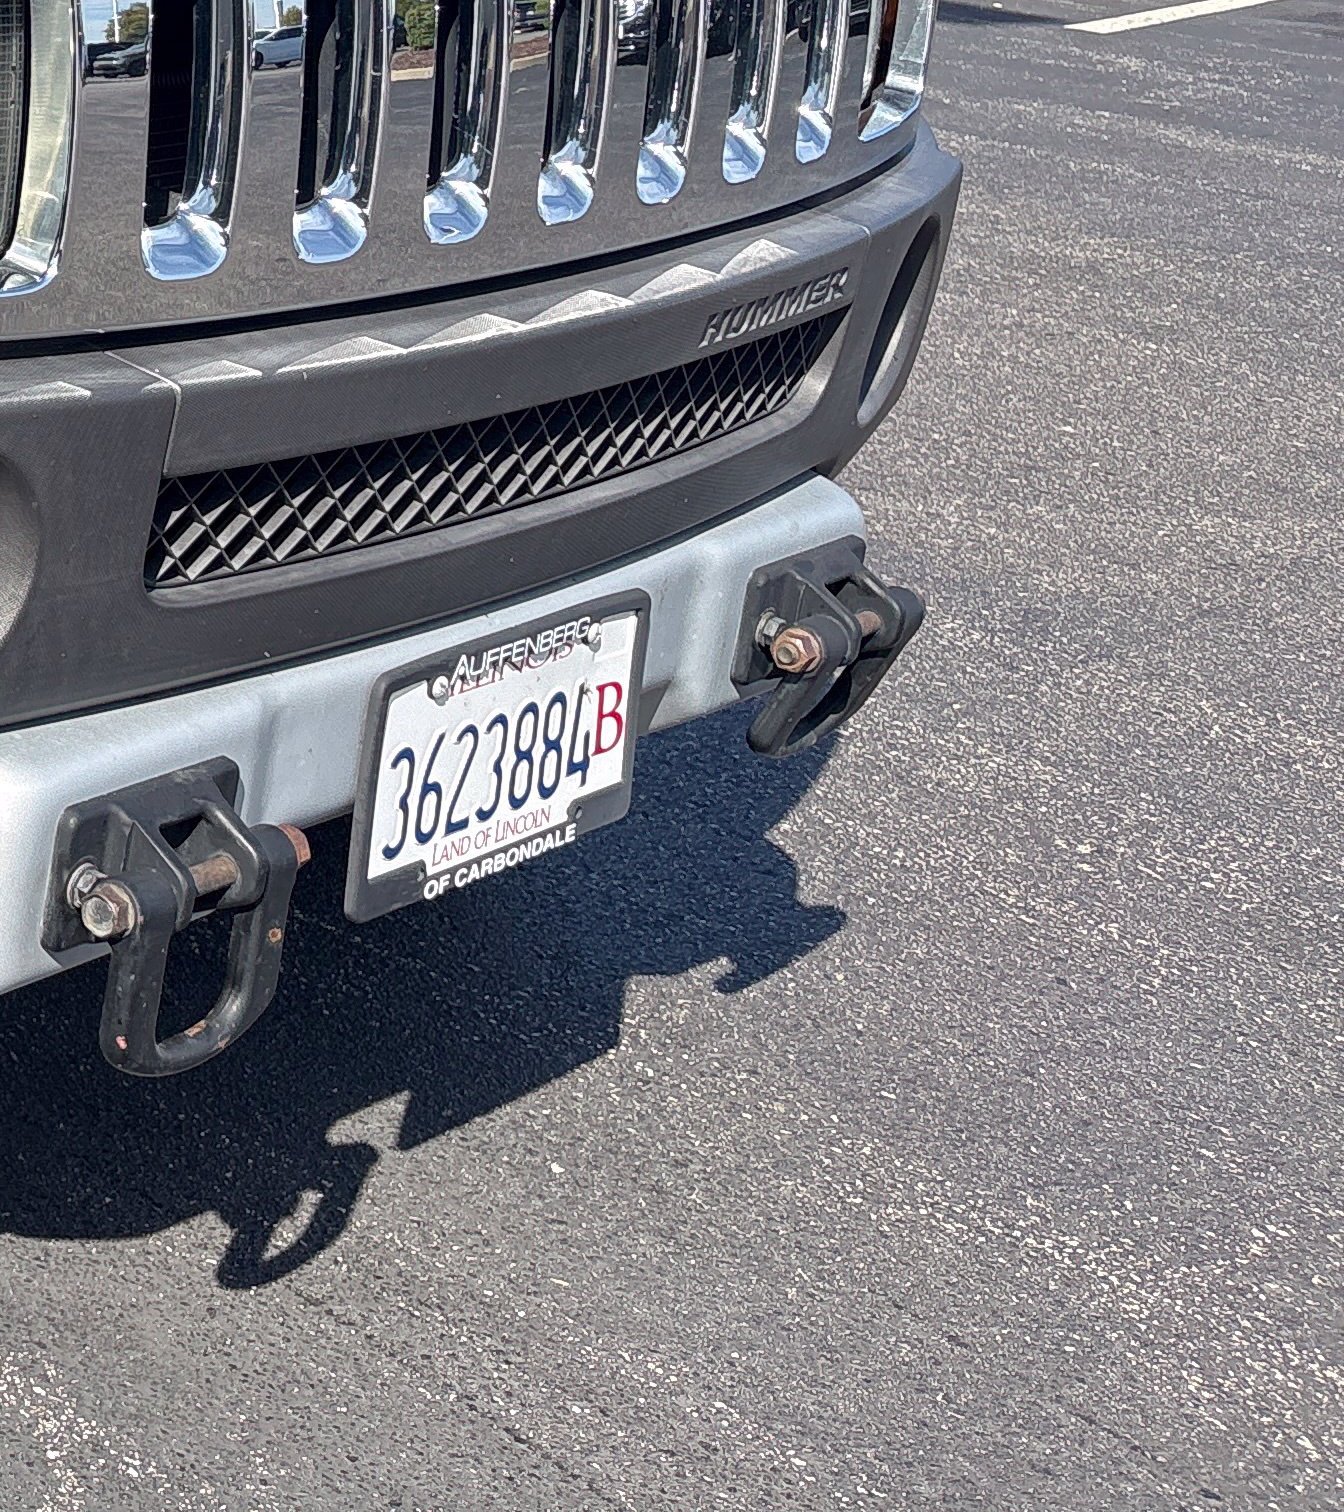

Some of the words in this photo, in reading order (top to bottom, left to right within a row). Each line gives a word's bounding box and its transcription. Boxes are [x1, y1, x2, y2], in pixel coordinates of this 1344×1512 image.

[698, 266, 849, 349] HUMMER
[450, 616, 591, 686] AUFFENBERG
[423, 878, 450, 900] OF
[454, 822, 577, 888] CARBONDALE
[432, 837, 471, 867] LAND
[474, 826, 492, 850] OF
[494, 804, 552, 843] LINCOLN
